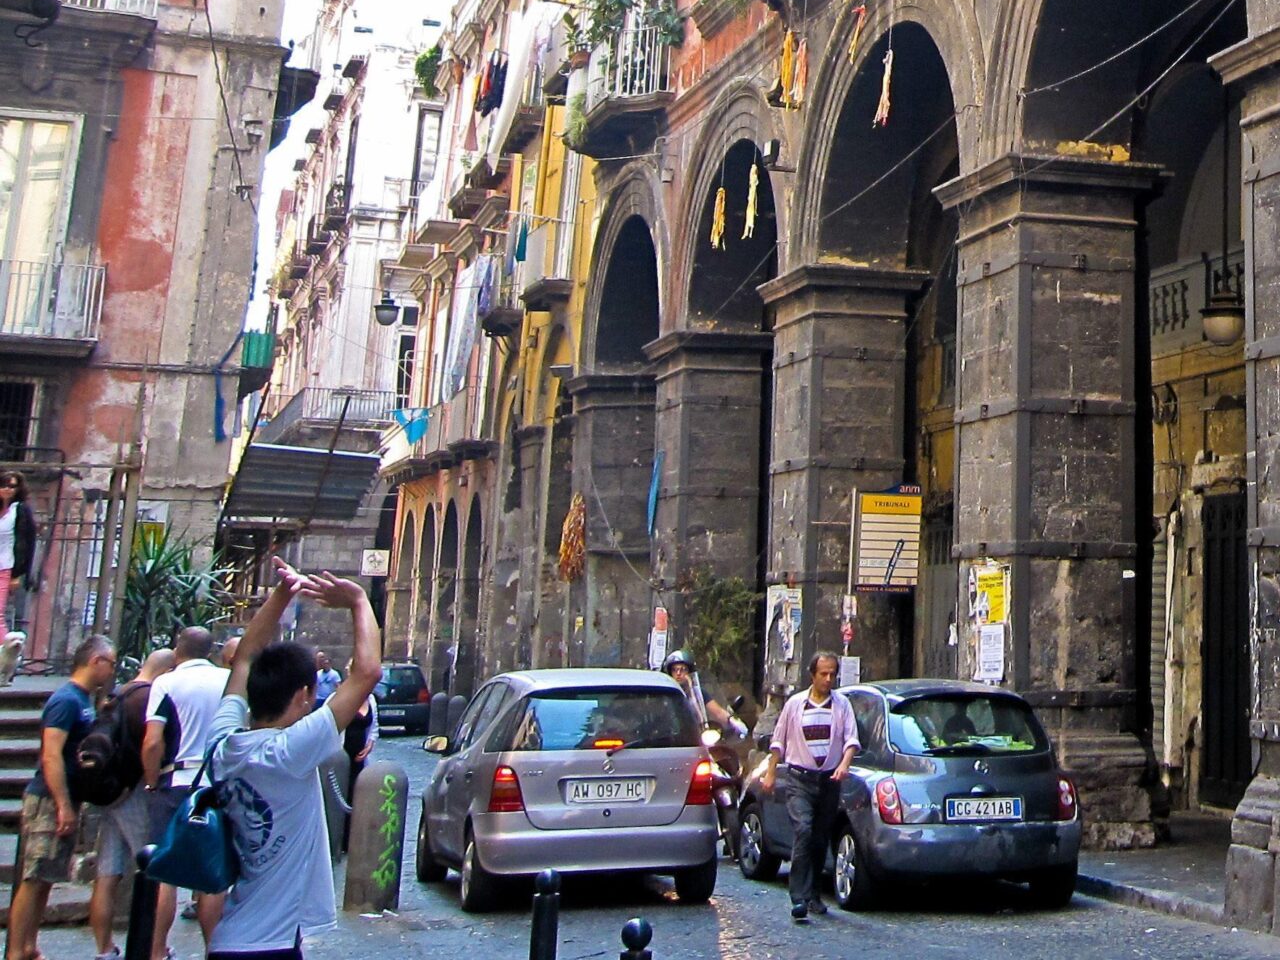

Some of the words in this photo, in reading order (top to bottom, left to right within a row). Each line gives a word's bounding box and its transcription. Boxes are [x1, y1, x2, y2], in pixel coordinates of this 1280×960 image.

[899, 485, 920, 494] anm
[573, 784, 590, 799] AW
[599, 783, 622, 798] 097
[626, 783, 642, 797] HC
[956, 802, 971, 816] CG
[975, 801, 1012, 815] 421AB
